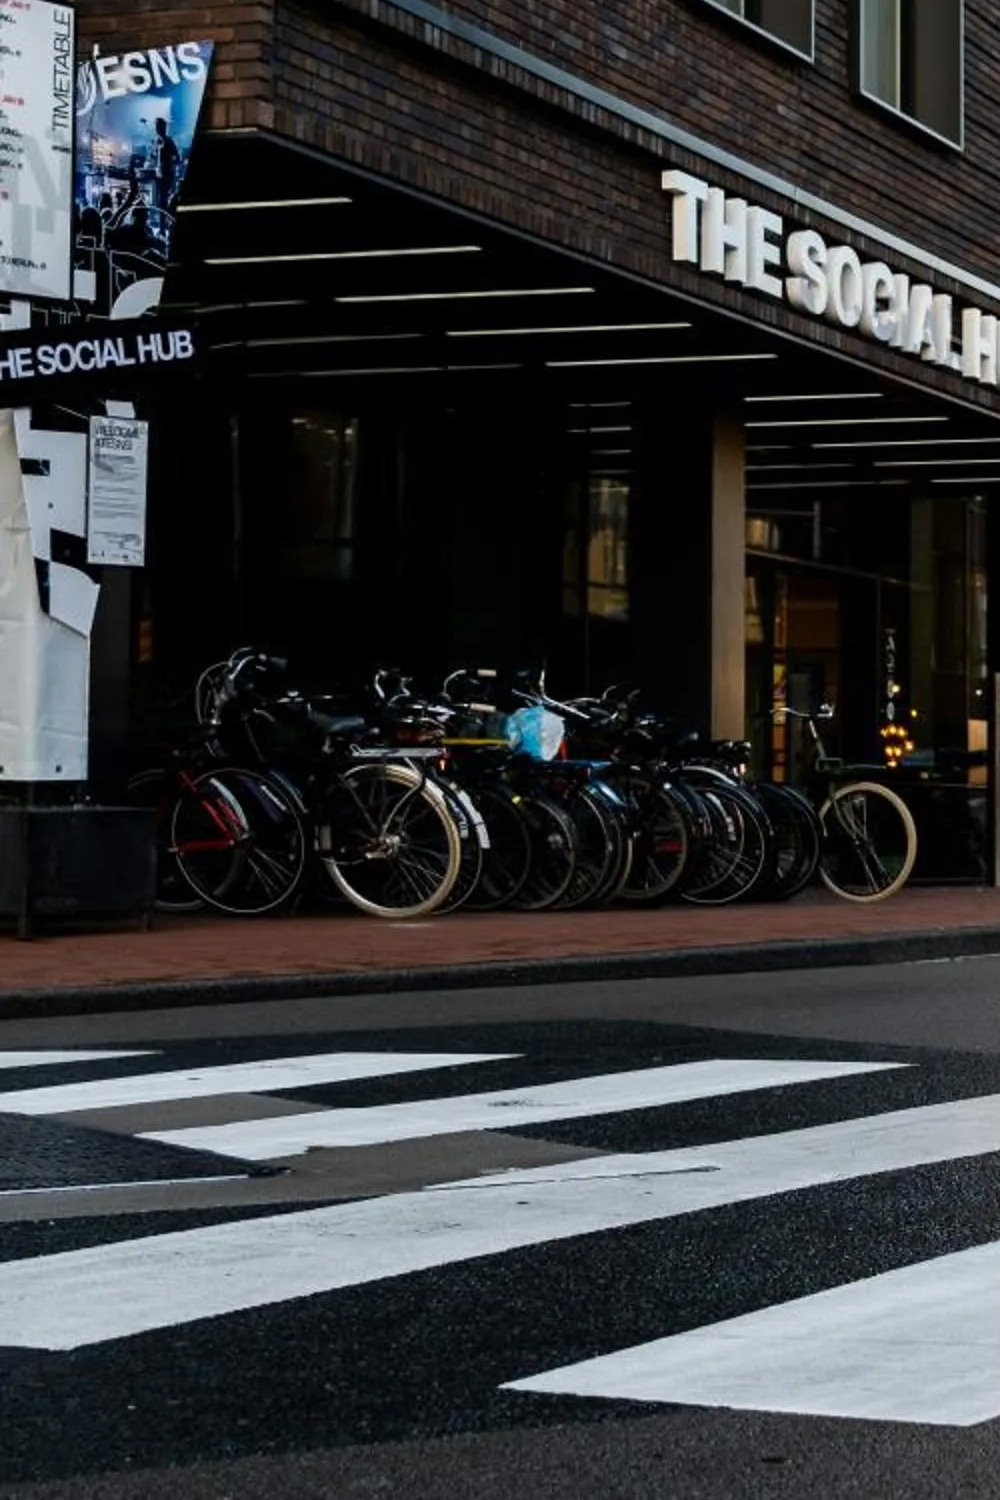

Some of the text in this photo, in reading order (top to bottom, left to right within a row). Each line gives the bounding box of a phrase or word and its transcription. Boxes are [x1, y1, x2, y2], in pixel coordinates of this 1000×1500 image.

[52, 8, 71, 131] TIMETABLE
[96, 41, 205, 100] ESNS
[661, 169, 784, 299] THE
[785, 229, 963, 372] SOCIAL
[0, 330, 195, 380] HE SOCIAL HUB
